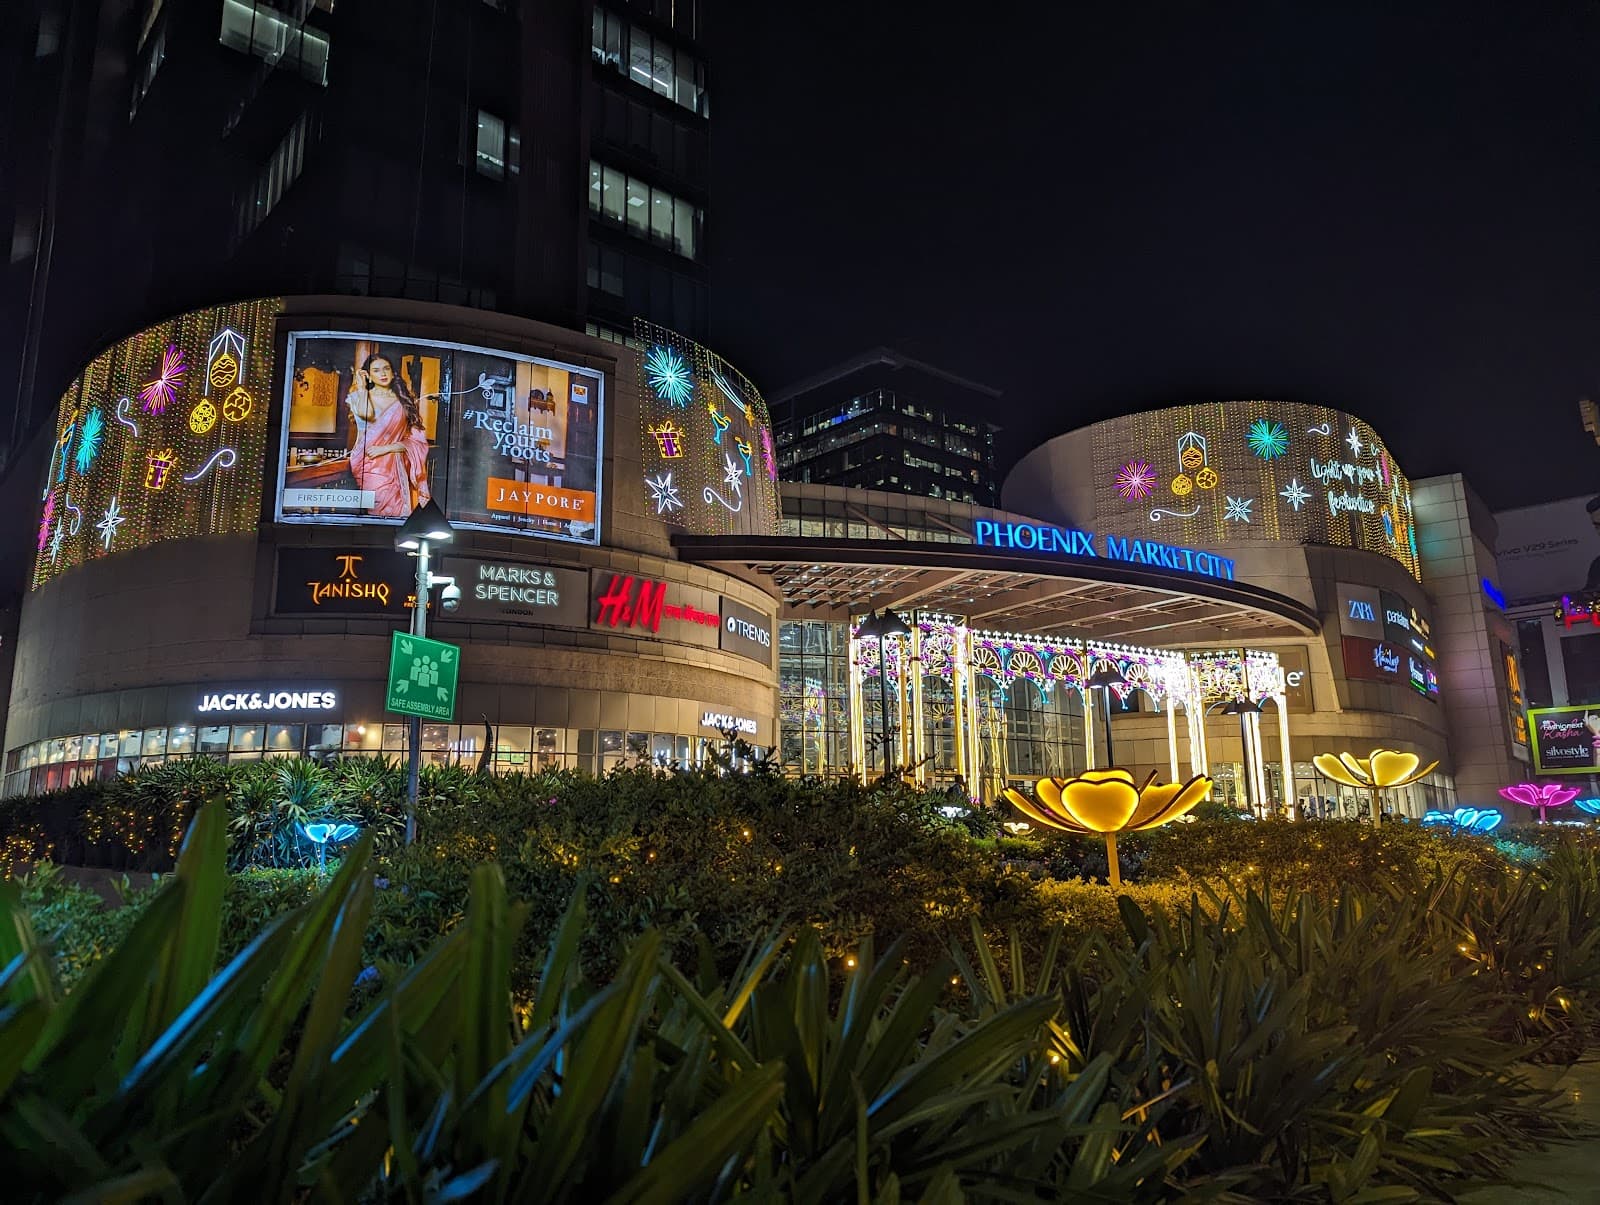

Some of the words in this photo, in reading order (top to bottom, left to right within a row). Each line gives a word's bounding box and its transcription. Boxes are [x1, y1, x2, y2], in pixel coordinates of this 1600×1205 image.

[463, 409, 554, 440] #Reclaim
[493, 432, 538, 450] your
[501, 444, 550, 462] roots
[297, 494, 324, 502] FIRST
[326, 494, 360, 503] FLOOR
[496, 488, 582, 511] JAYPORE
[975, 520, 1097, 557] PHOENIX
[480, 564, 541, 586] MARKS
[543, 571, 555, 587] &
[475, 583, 559, 606] SPENCER
[596, 574, 667, 633] H&M
[1348, 600, 1375, 621] ZARA
[736, 619, 770, 648] TRENDS
[198, 692, 336, 712] JACK&JONES
[391, 698, 406, 709] SAFE
[406, 701, 435, 713] ASSEMBLY
[435, 705, 450, 717] AREA
[701, 712, 757, 734] JACK&JONES
